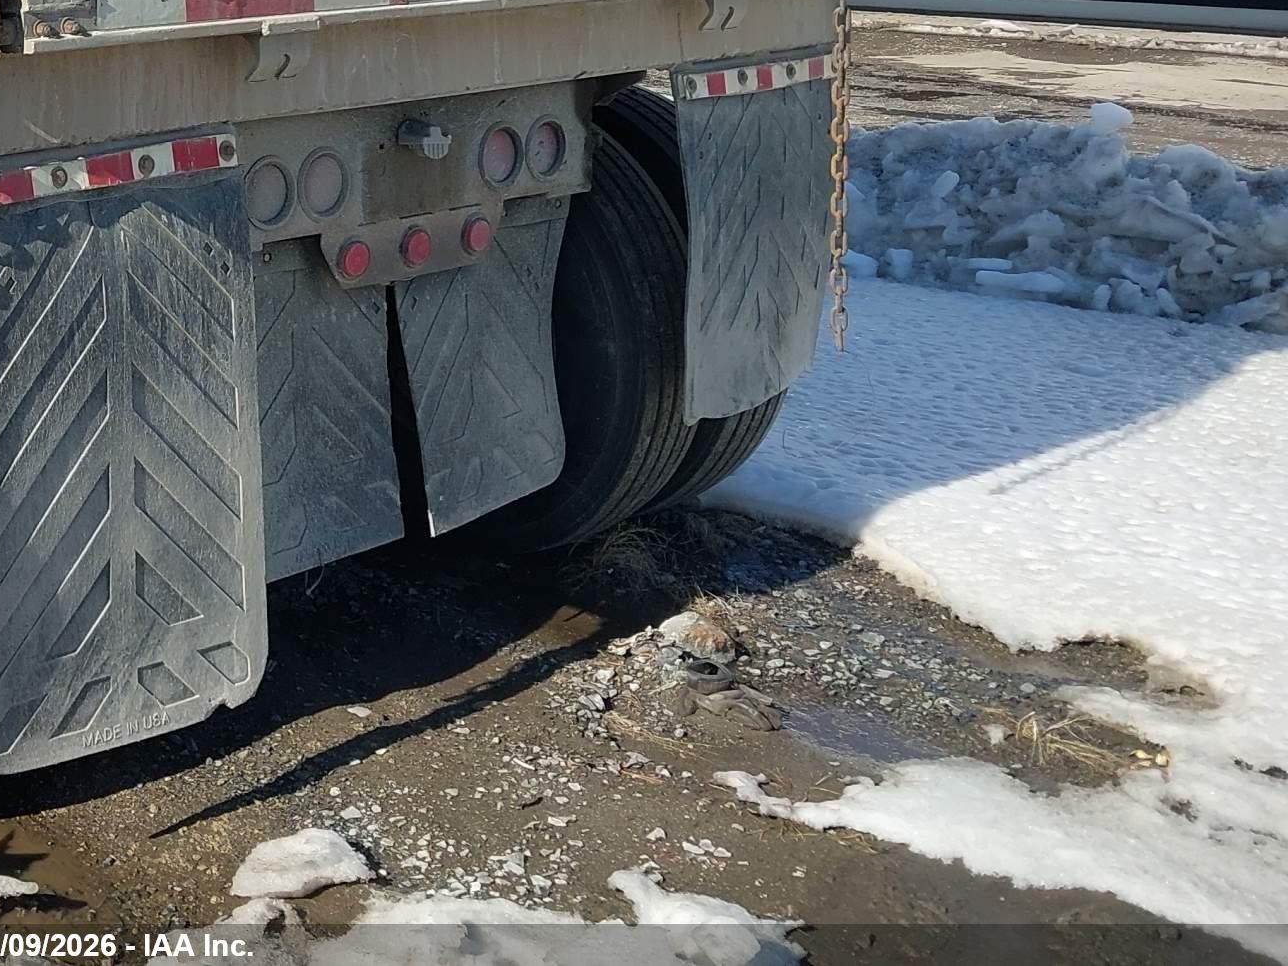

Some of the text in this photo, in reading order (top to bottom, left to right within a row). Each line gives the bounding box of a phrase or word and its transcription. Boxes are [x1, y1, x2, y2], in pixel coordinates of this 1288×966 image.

[82, 711, 170, 747] MADE IN USA
